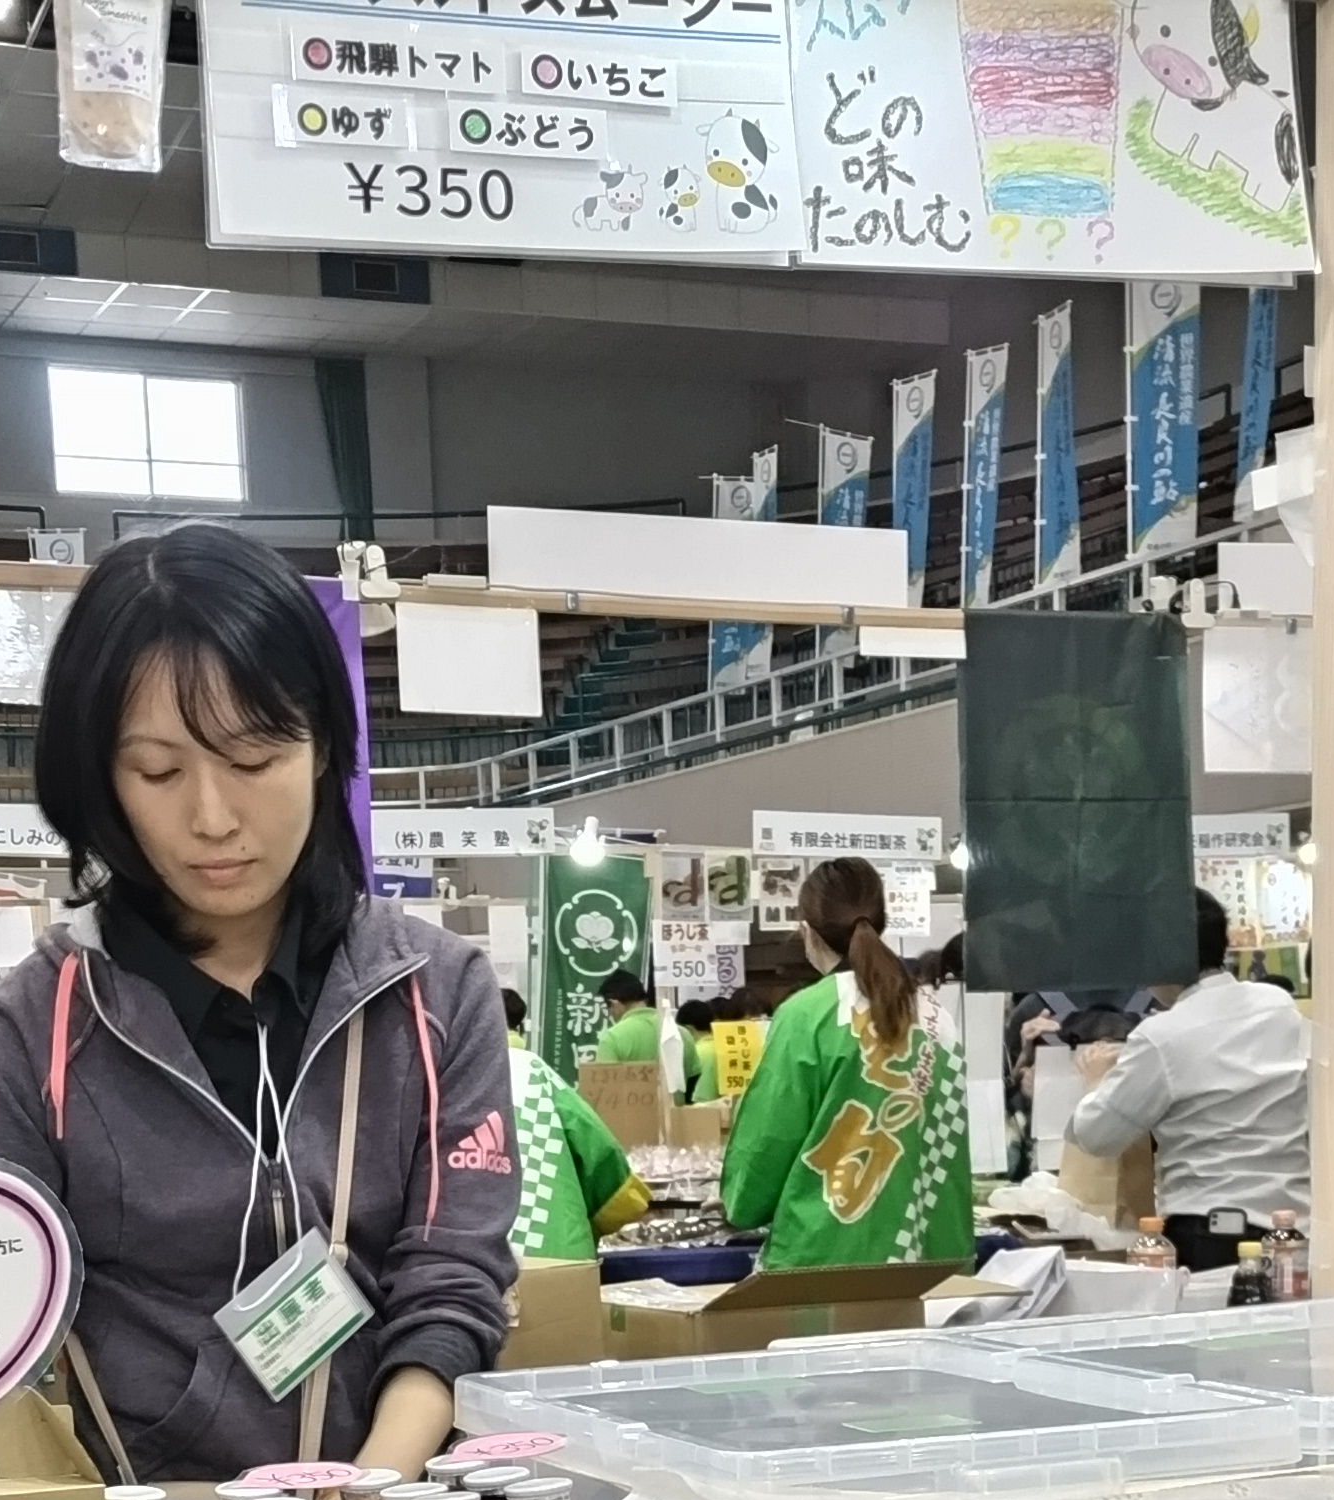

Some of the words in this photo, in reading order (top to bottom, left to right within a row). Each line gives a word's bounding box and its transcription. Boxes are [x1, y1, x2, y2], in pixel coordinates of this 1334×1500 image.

[334, 38, 495, 85] 飛騨トマト
[823, 65, 923, 146] どの
[328, 105, 395, 141] ゆず
[494, 110, 598, 153] ぶどう
[843, 140, 916, 195] 味
[346, 159, 516, 223] ¥350
[804, 184, 972, 254] たのしむ
[789, 831, 908, 852] 有限会社新田製茶
[1193, 831, 1264, 849] 稲作研究会
[661, 923, 710, 943] ほうじ茶
[671, 960, 706, 978] 550
[447, 1149, 513, 1176] adidas
[470, 1437, 555, 1456] ¥350
[256, 1468, 353, 1486] ¥350
